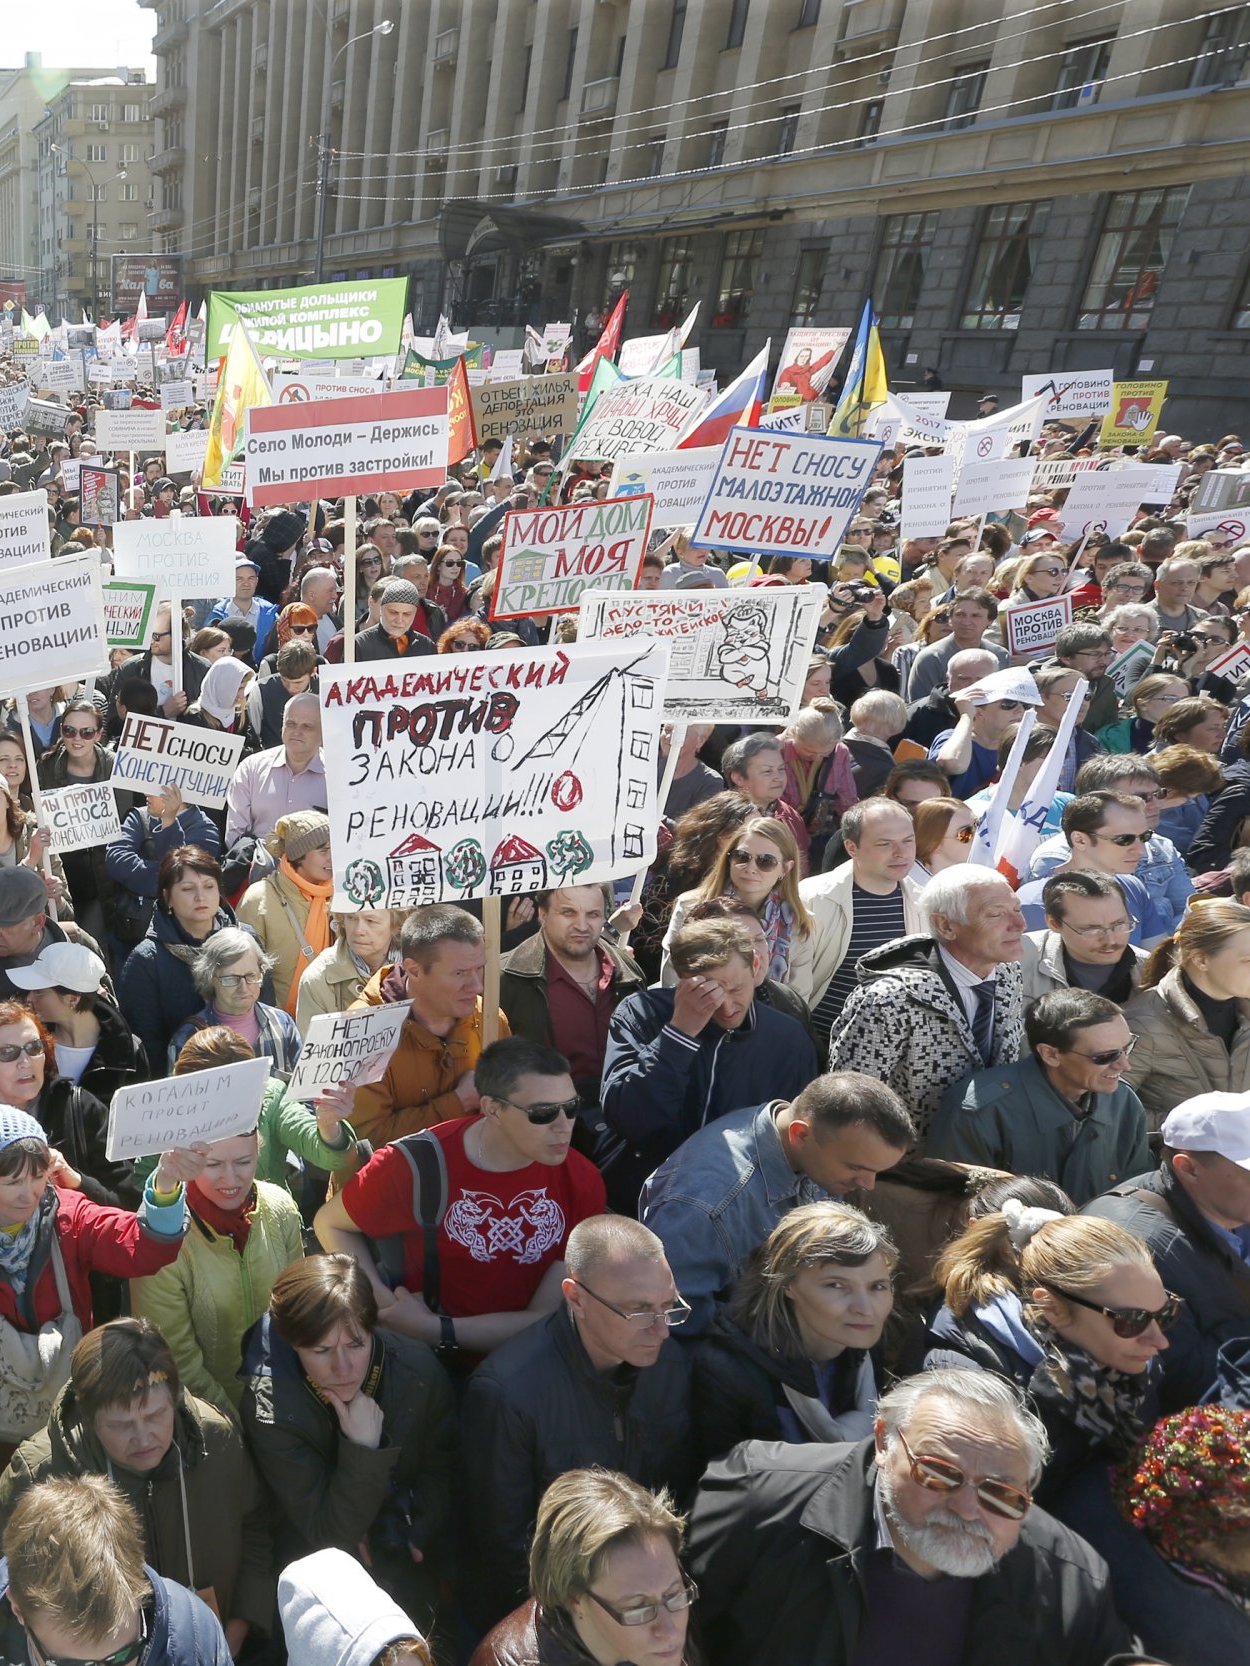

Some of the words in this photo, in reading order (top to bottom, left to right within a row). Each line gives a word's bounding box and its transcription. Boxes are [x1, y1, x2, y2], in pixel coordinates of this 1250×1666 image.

[234, 298, 297, 314] ОБМАНУТЫЕ
[300, 290, 377, 308] ДОЛЬЩИКИ
[243, 313, 286, 328] ЖИЛОЙ
[290, 306, 370, 323] КОМПЛЕКС
[316, 384, 346, 392] ПРОТИВ
[660, 384, 697, 408] НАШ
[1058, 380, 1110, 390] ГОЛОВИНО
[1072, 390, 1110, 400] ПРОТИВ
[482, 394, 565, 419] ДЕПОРТАЦИЯ
[515, 407, 534, 417] ЭТО
[647, 402, 689, 431] ХРУЩ
[1050, 401, 1109, 411] РЕНОВАЦИИ
[481, 414, 562, 437] РЕНОВАЦИЯ
[608, 419, 666, 442] ВОВОЙ
[916, 415, 941, 429] 2017
[247, 438, 287, 454] Село
[292, 431, 352, 449] Молоди
[259, 466, 285, 483] Мы
[289, 463, 344, 481] против
[349, 451, 433, 474] застройки!
[652, 461, 715, 474] АКАДЕМИЧЕСКИЙ
[727, 437, 791, 473] НЕТ
[792, 452, 867, 479] СНОСУ
[914, 468, 942, 476] ПРОТИВ
[657, 479, 696, 490] ПРОТИВ
[715, 476, 864, 509] МАЛОЭТАЖНОЙ
[908, 485, 947, 493] ПРИНЯТИЯ
[653, 495, 705, 508] НОВАЦИИ!
[509, 510, 585, 548] МОЙ
[584, 504, 645, 544] ДОМ
[704, 510, 833, 547] МОСКВЫ!
[904, 520, 948, 528] РЕНОВАЦИИ
[137, 531, 203, 547] МОСКВА
[138, 553, 209, 568] ПРОТИВ
[551, 539, 635, 578] МОЯ
[498, 572, 635, 613] КРЕПОСТЬ
[1, 603, 71, 630] ПРОТИВ
[603, 618, 673, 637] ДЕЛО-ТО
[1014, 609, 1061, 627] МОСКВА
[1015, 618, 1062, 637] ПРОТИВ
[1017, 630, 1057, 645] РЕНОВАЦИ
[325, 651, 570, 707] АКАДЕМИЧЕСКИЙ
[352, 692, 520, 749] ПРОТИВ
[120, 718, 174, 753] НЕТ
[167, 736, 233, 766] СНОСУ
[349, 739, 474, 786] ЗАКОНА
[491, 732, 515, 762] О
[113, 751, 231, 797] КОНСТИТУЦИИ
[64, 787, 111, 809] ПРОТИВ
[346, 773, 553, 842] РЕНОВАЦИИ!!!
[331, 1014, 375, 1040] НЕТ
[301, 1027, 397, 1061] ЗАКОНОПРОЕКТУ
[125, 1075, 231, 1110] КОГАЛЫМ
[142, 1101, 209, 1121] ПРОСИТ
[120, 1113, 239, 1148] РЕНОВАЦИЮ
